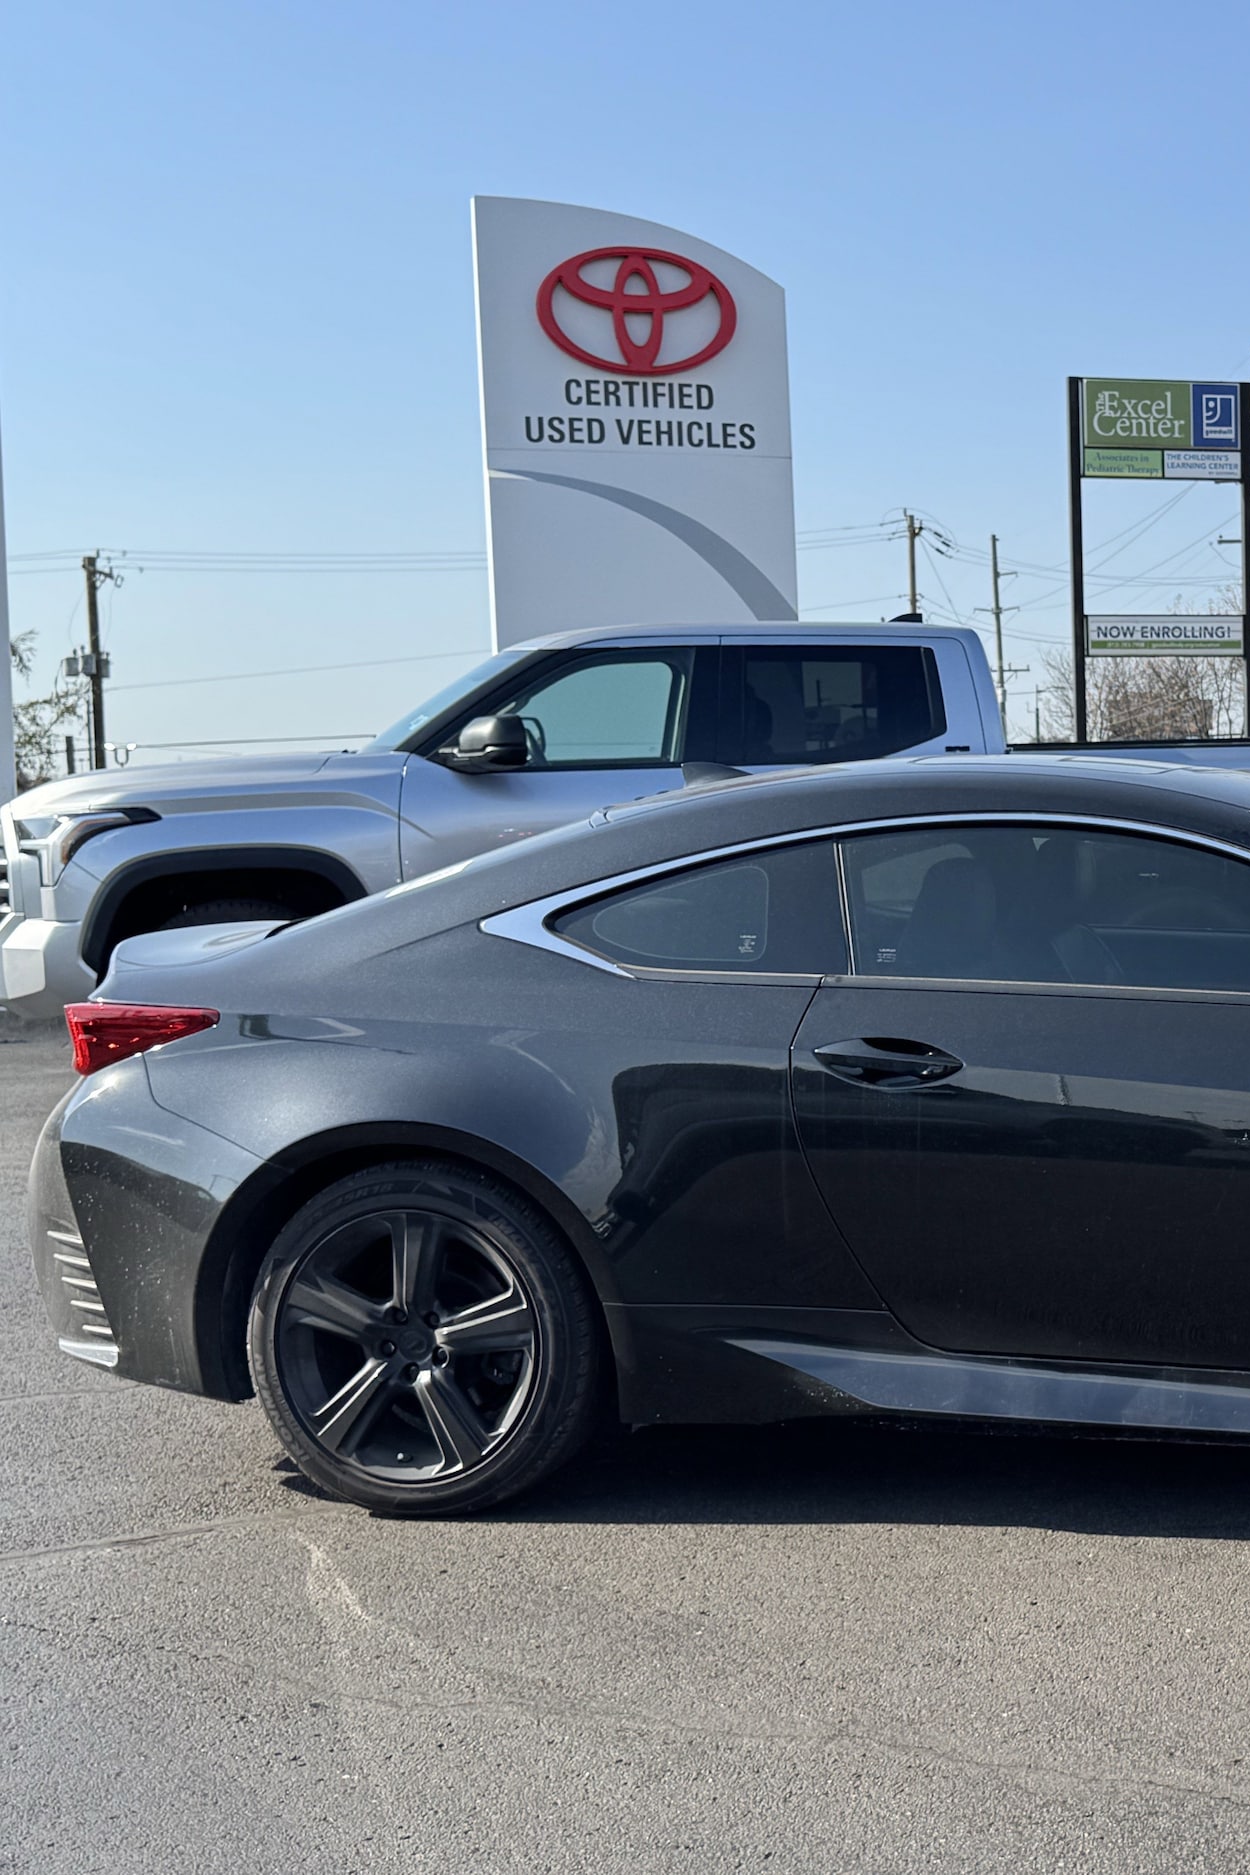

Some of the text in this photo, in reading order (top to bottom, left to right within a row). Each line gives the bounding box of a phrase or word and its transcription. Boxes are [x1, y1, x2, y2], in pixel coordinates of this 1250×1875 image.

[564, 378, 715, 411] CERTIFIED
[1102, 390, 1174, 419] Excel
[525, 416, 756, 450] USED VEHICLES
[1093, 410, 1185, 438] Center
[1086, 463, 1160, 477] Pediatric Therapy
[1095, 452, 1150, 462] Associates in
[1183, 454, 1229, 462] CHILDREN'S
[1096, 625, 1231, 639] NOW ENROLLING!
[254, 1352, 311, 1464] IRONMAN
